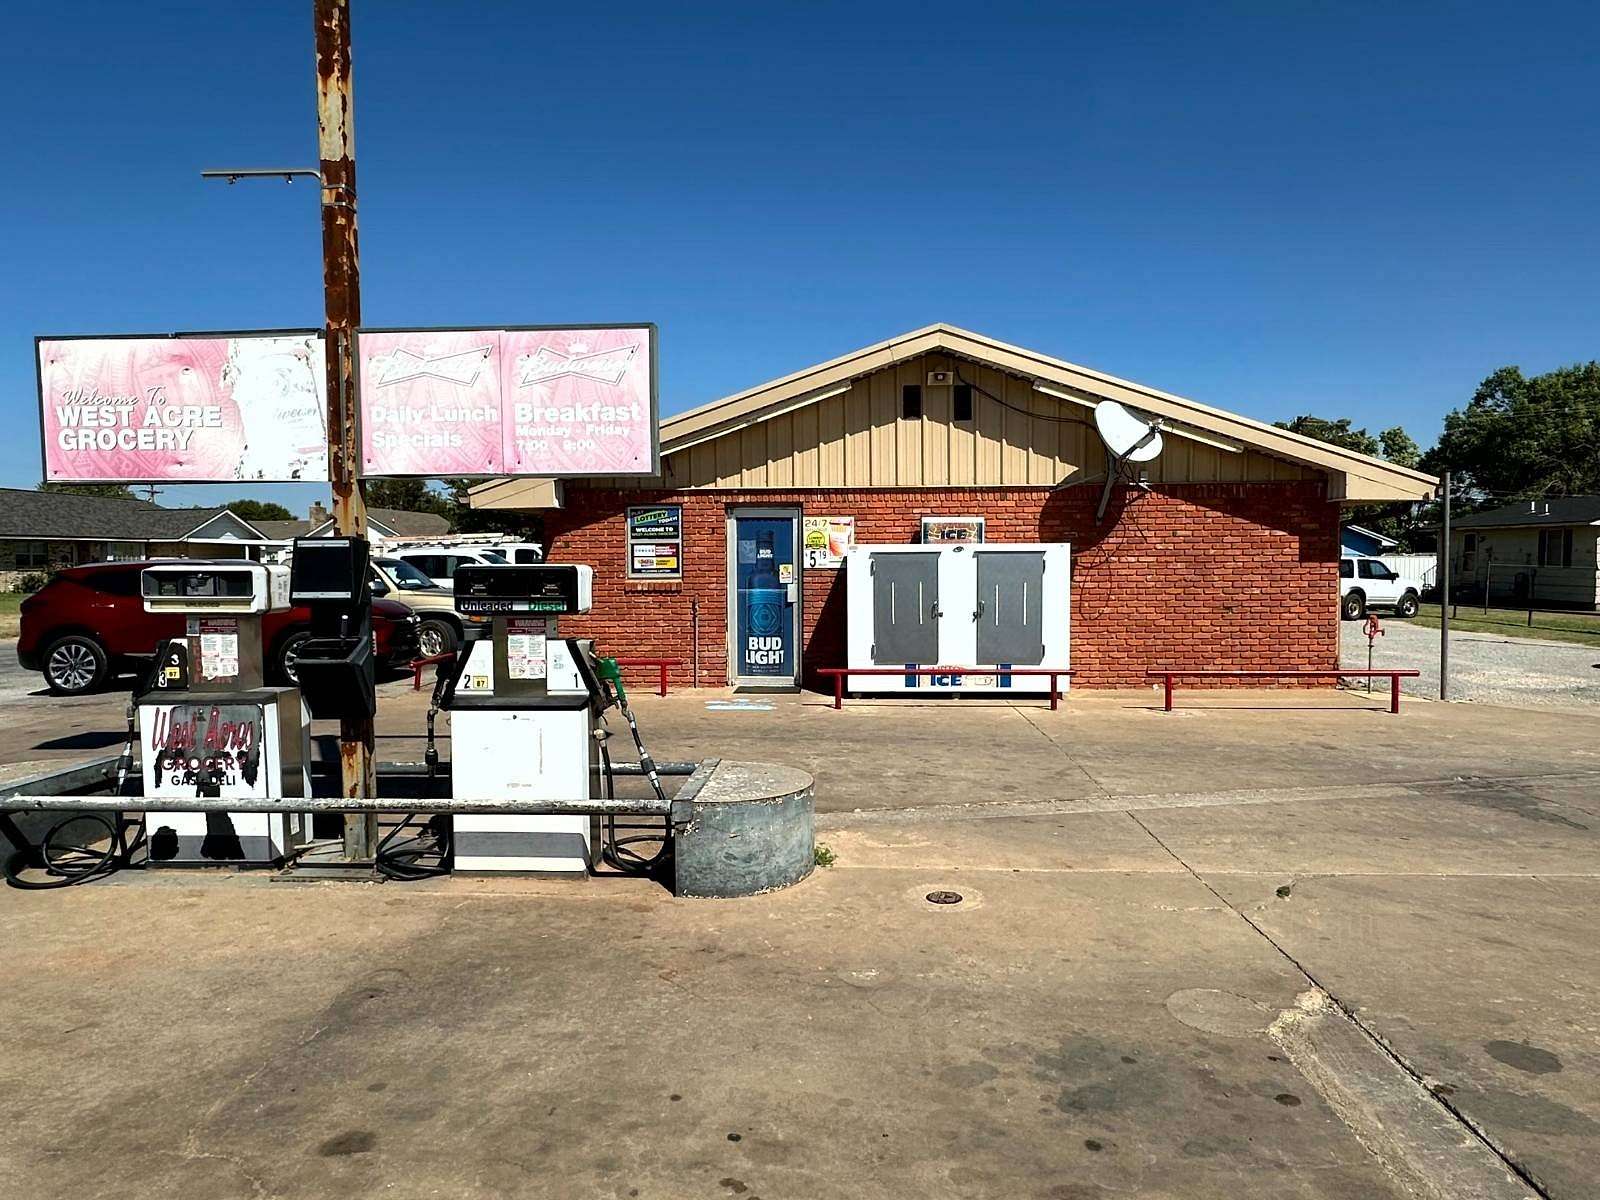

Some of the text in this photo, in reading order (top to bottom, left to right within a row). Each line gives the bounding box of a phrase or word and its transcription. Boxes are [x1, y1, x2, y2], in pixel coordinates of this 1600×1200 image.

[62, 385, 168, 406] Welcome To
[56, 405, 222, 428] WEST ACRE
[371, 404, 497, 425] Daily Lunch
[514, 401, 641, 423] Breakfast
[516, 424, 571, 438] Monday
[585, 424, 630, 437] Friday
[57, 428, 195, 452] GROCERY
[372, 430, 463, 450] Specials
[635, 511, 667, 523] LOTTERY
[941, 529, 967, 540] ICE
[462, 599, 566, 611] Unleaded Diesel
[748, 636, 782, 651] BUD
[170, 653, 180, 665] 3
[745, 649, 784, 665] LIGHT
[159, 672, 166, 686] 3
[463, 674, 471, 689] 2
[573, 673, 579, 688] 1
[930, 674, 963, 686] ICE
[152, 707, 197, 751] West
[162, 756, 248, 772] GROCERY
[171, 775, 236, 786] GAS DELI
